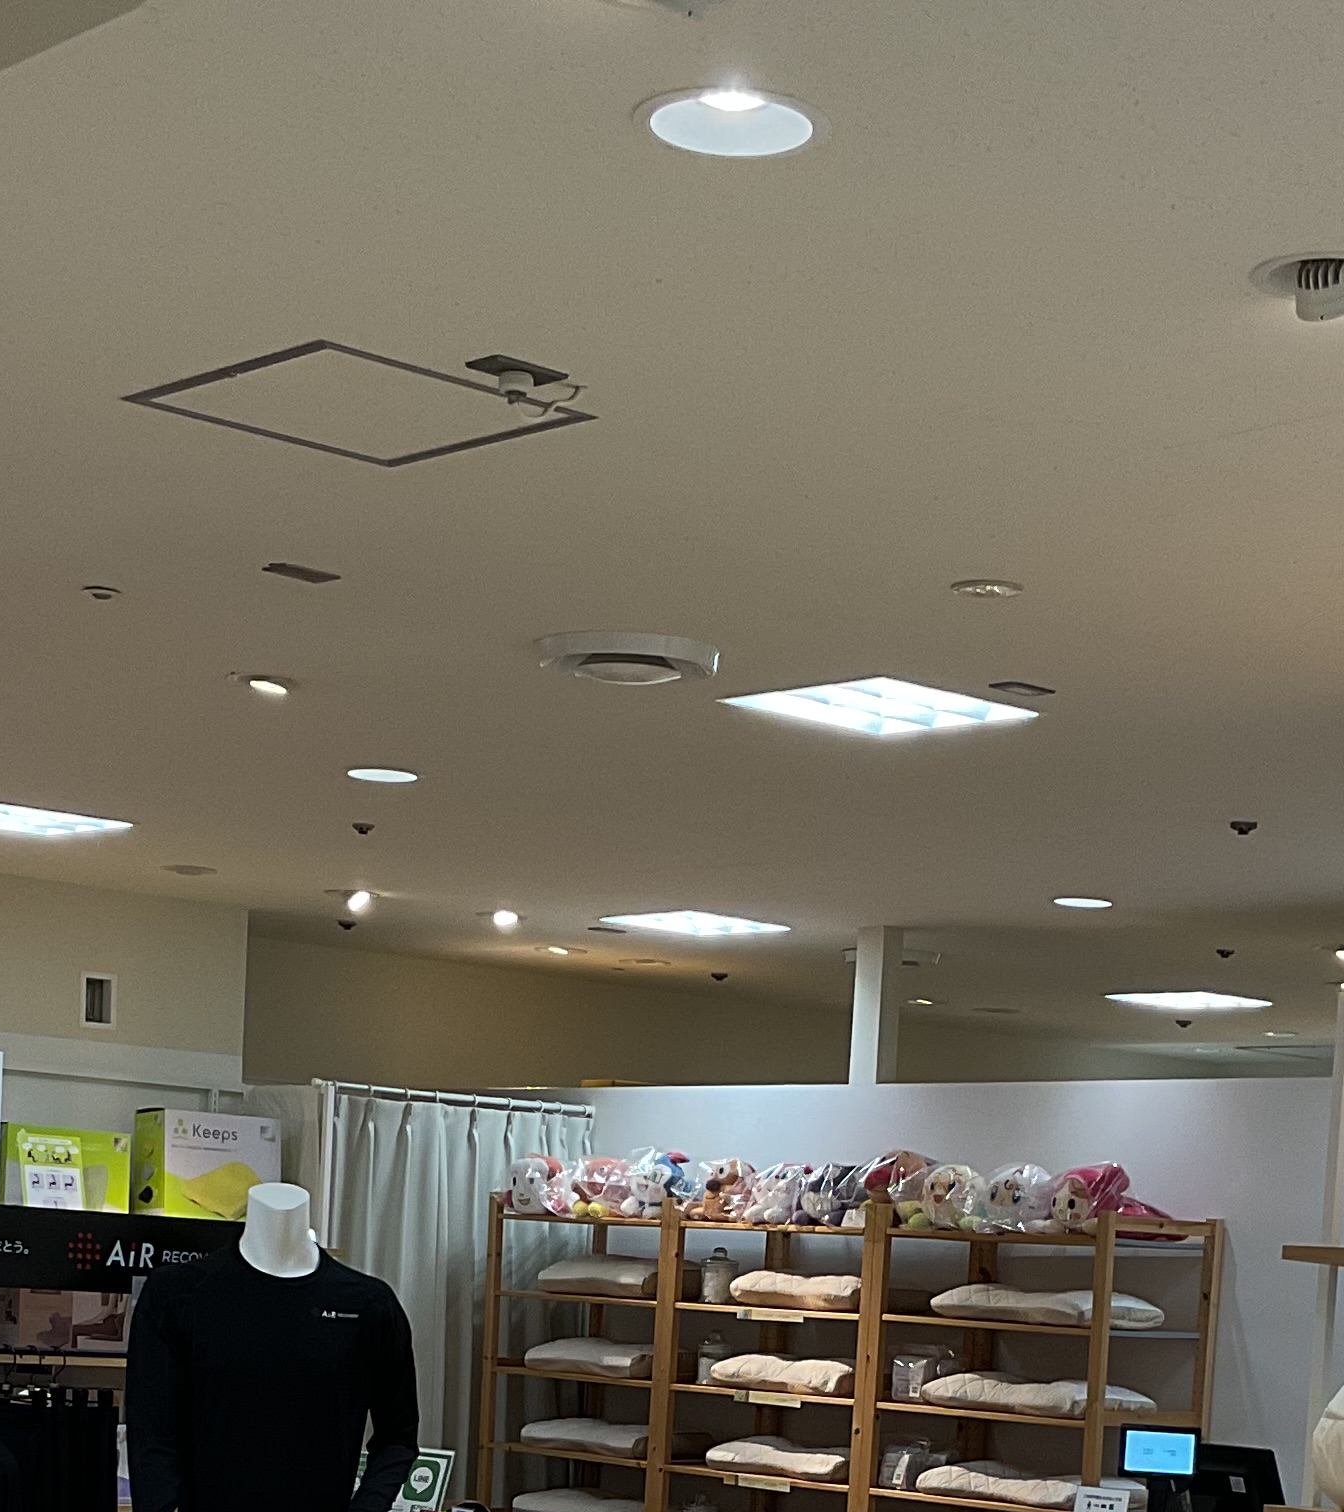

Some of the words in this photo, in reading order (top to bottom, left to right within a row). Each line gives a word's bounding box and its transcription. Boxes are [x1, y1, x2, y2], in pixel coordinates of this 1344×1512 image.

[192, 1123, 238, 1143] Keeps
[106, 1239, 155, 1269] AiR
[413, 1475, 430, 1483] LINE
